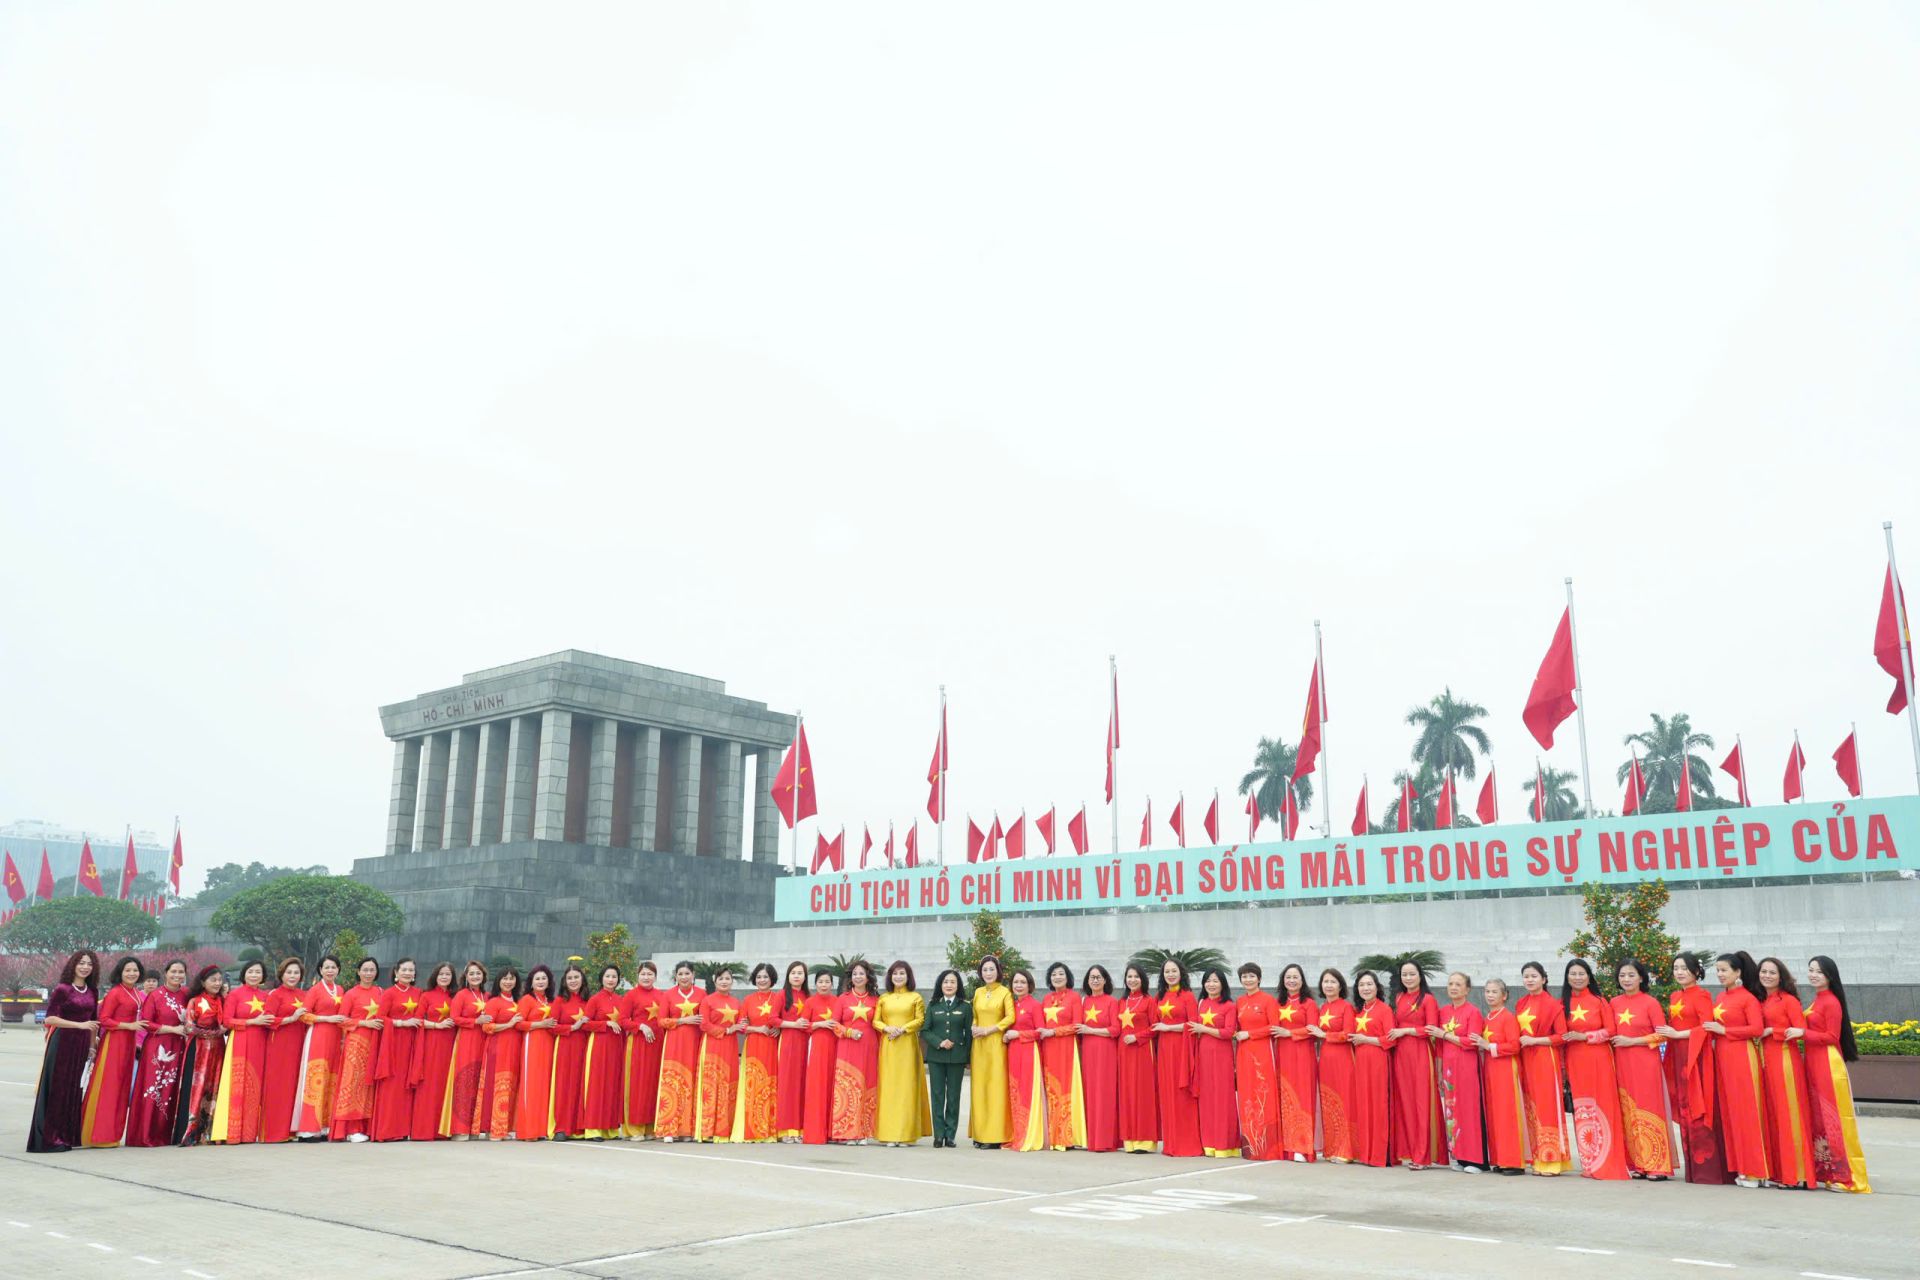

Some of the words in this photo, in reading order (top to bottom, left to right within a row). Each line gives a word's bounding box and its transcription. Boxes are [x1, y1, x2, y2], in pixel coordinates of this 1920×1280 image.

[811, 875, 851, 913] CHỦ
[861, 879, 910, 916] TỊCH
[920, 867, 950, 907] HỒ
[961, 867, 1001, 905] CHÍ
[1013, 867, 1082, 902] MINH
[1095, 860, 1121, 899] VĨ
[1135, 861, 1184, 902] ĐẠI
[1199, 845, 1285, 893] SỐNG
[1300, 843, 1366, 889] MÃI
[1381, 840, 1509, 884] TRONG
[1526, 828, 1582, 882] SỰ
[1598, 816, 1771, 875] NGHIỆP
[1791, 803, 1899, 863] CỦA
